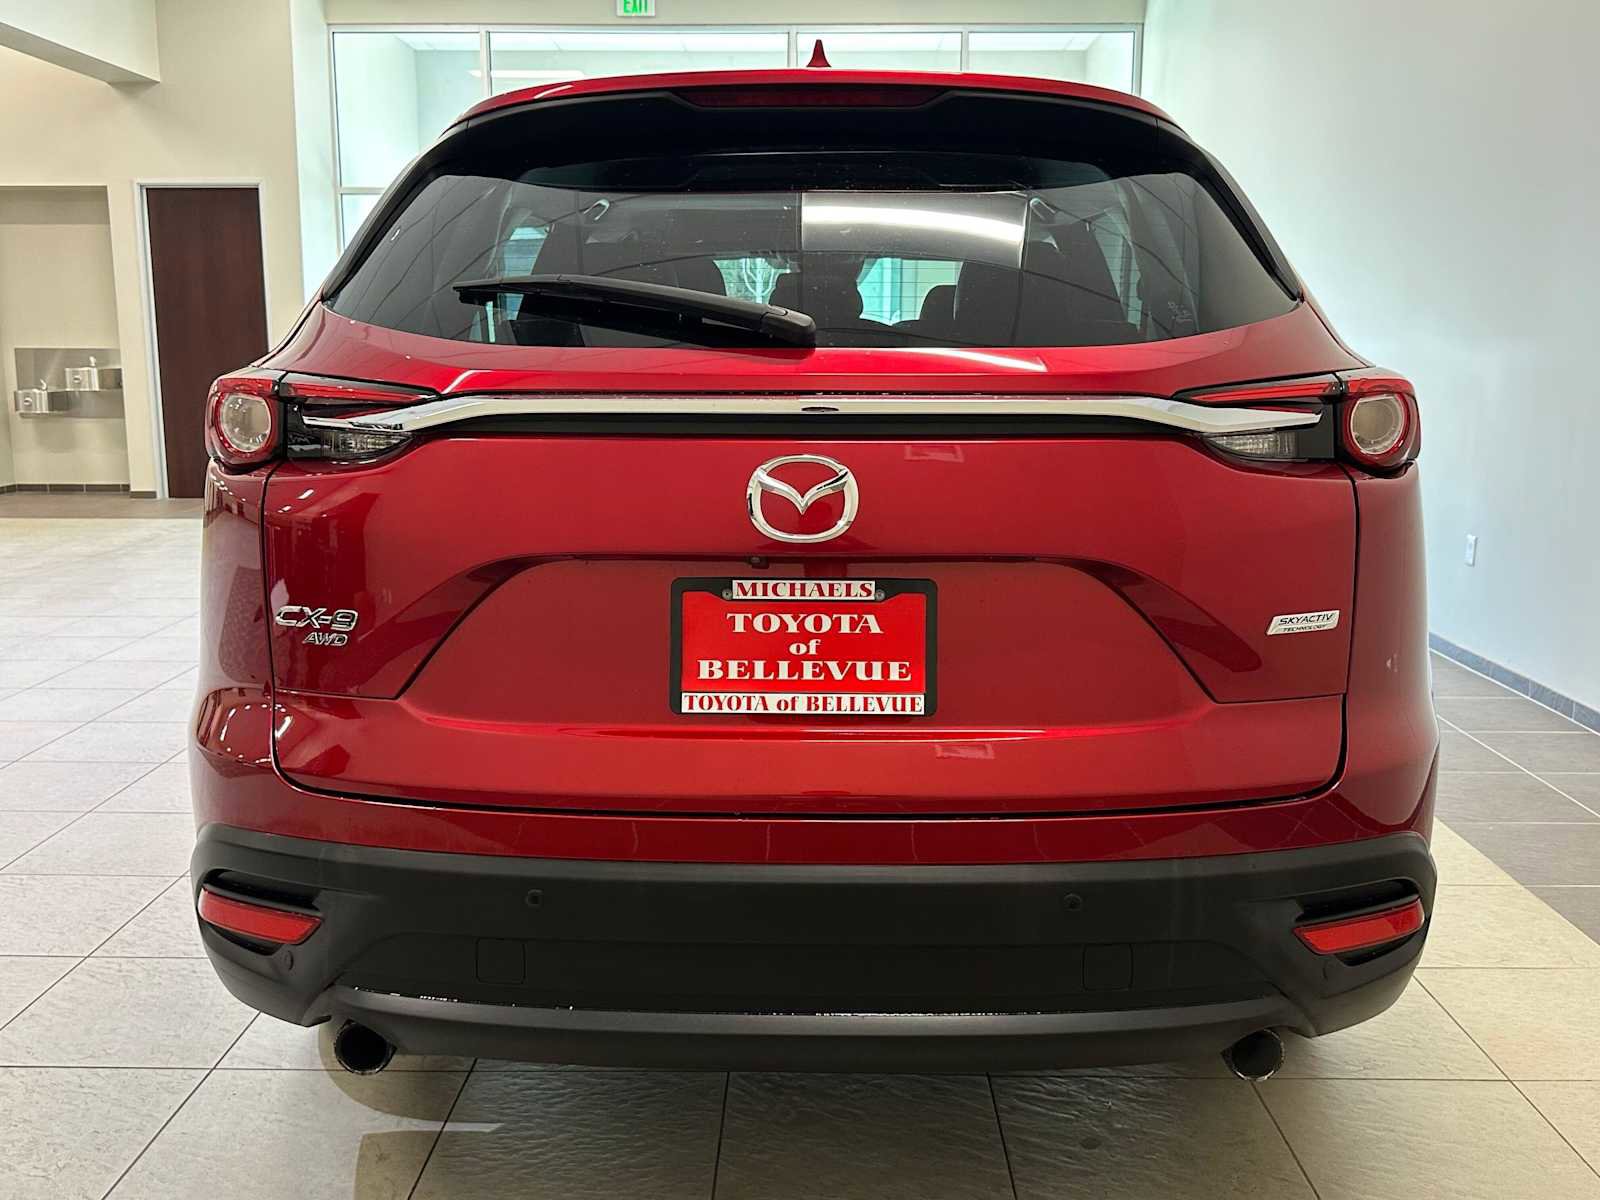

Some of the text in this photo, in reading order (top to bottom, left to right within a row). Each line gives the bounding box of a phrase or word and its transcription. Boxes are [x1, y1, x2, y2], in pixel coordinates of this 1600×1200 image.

[735, 582, 873, 597] MICHAELS
[275, 605, 358, 631] CX-9
[726, 613, 884, 634] TOYOTA
[1279, 613, 1334, 625] SKYACTIV
[302, 632, 348, 647] AWD
[789, 639, 821, 655] of
[697, 659, 912, 681] BELLEVUE
[684, 695, 923, 713] TOYOTA of BELLEVUE
